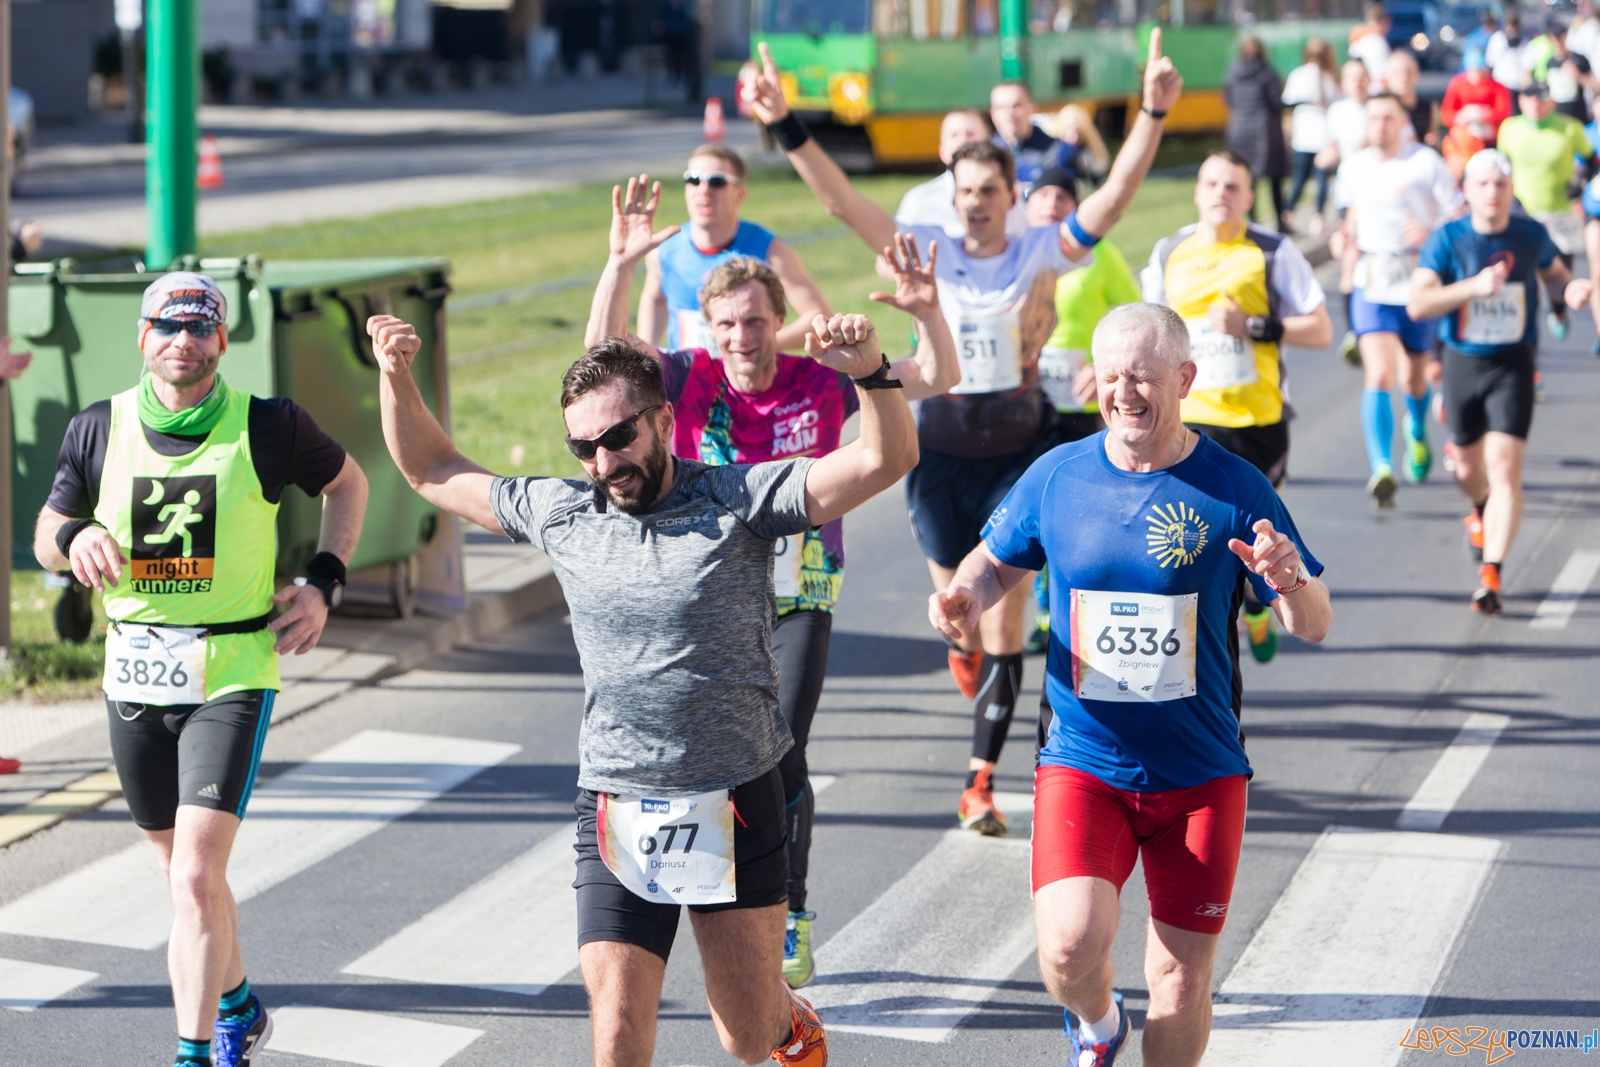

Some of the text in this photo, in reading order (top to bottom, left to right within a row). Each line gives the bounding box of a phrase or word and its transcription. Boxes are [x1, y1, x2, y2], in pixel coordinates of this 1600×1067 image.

[962, 339, 998, 359] 511
[771, 427, 819, 457] RUN
[146, 559, 199, 579] night
[131, 579, 211, 593] runners
[1096, 626, 1181, 656] 6336
[116, 657, 189, 688] 3826
[1118, 659, 1160, 670] Zbigniew
[139, 689, 164, 699] Marcin
[638, 823, 700, 856] 677
[650, 859, 687, 869] Dariusz
